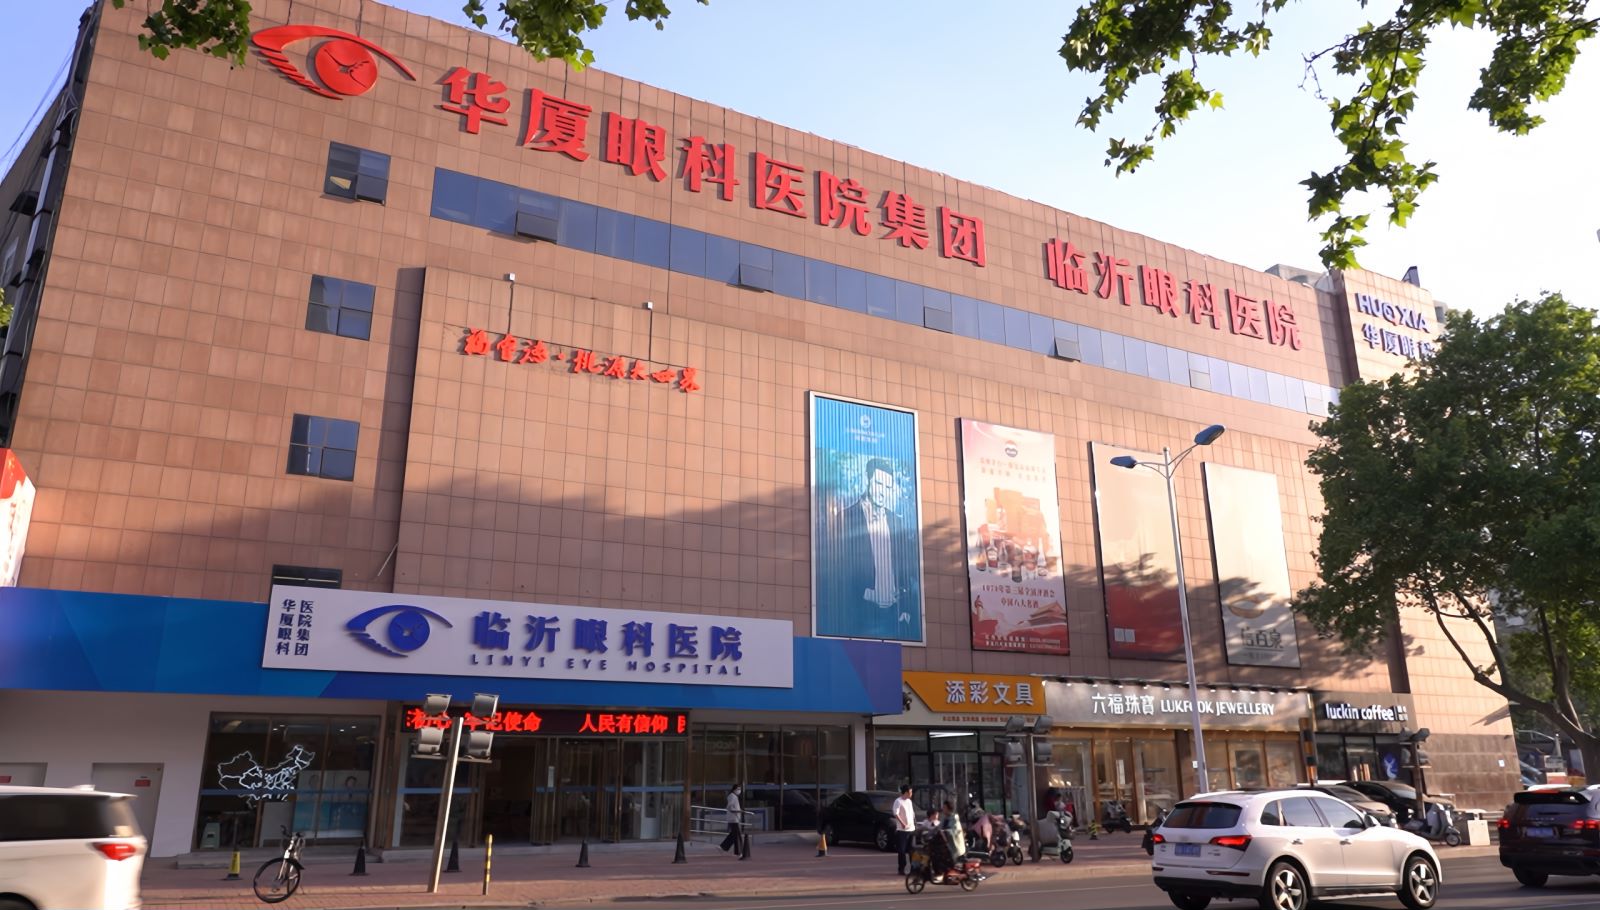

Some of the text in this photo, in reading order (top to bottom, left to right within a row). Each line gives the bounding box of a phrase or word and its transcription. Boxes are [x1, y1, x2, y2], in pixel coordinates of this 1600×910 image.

[440, 66, 1301, 351] 华厦眼科医院集团 临沂眼科医院
[275, 599, 296, 656] 华厦眼科
[294, 600, 314, 657] 医院集团
[473, 611, 742, 661] 临沂眼科医院
[471, 653, 742, 676] LINYI EYE HOSPITAL
[945, 680, 1035, 706] 添彩文具
[1092, 693, 1155, 715] 六福珠寶
[1216, 701, 1276, 716] JEWELLERY
[578, 713, 668, 733] 人民有信仰
[1325, 703, 1359, 720] luckin
[1360, 704, 1395, 721] coffee
